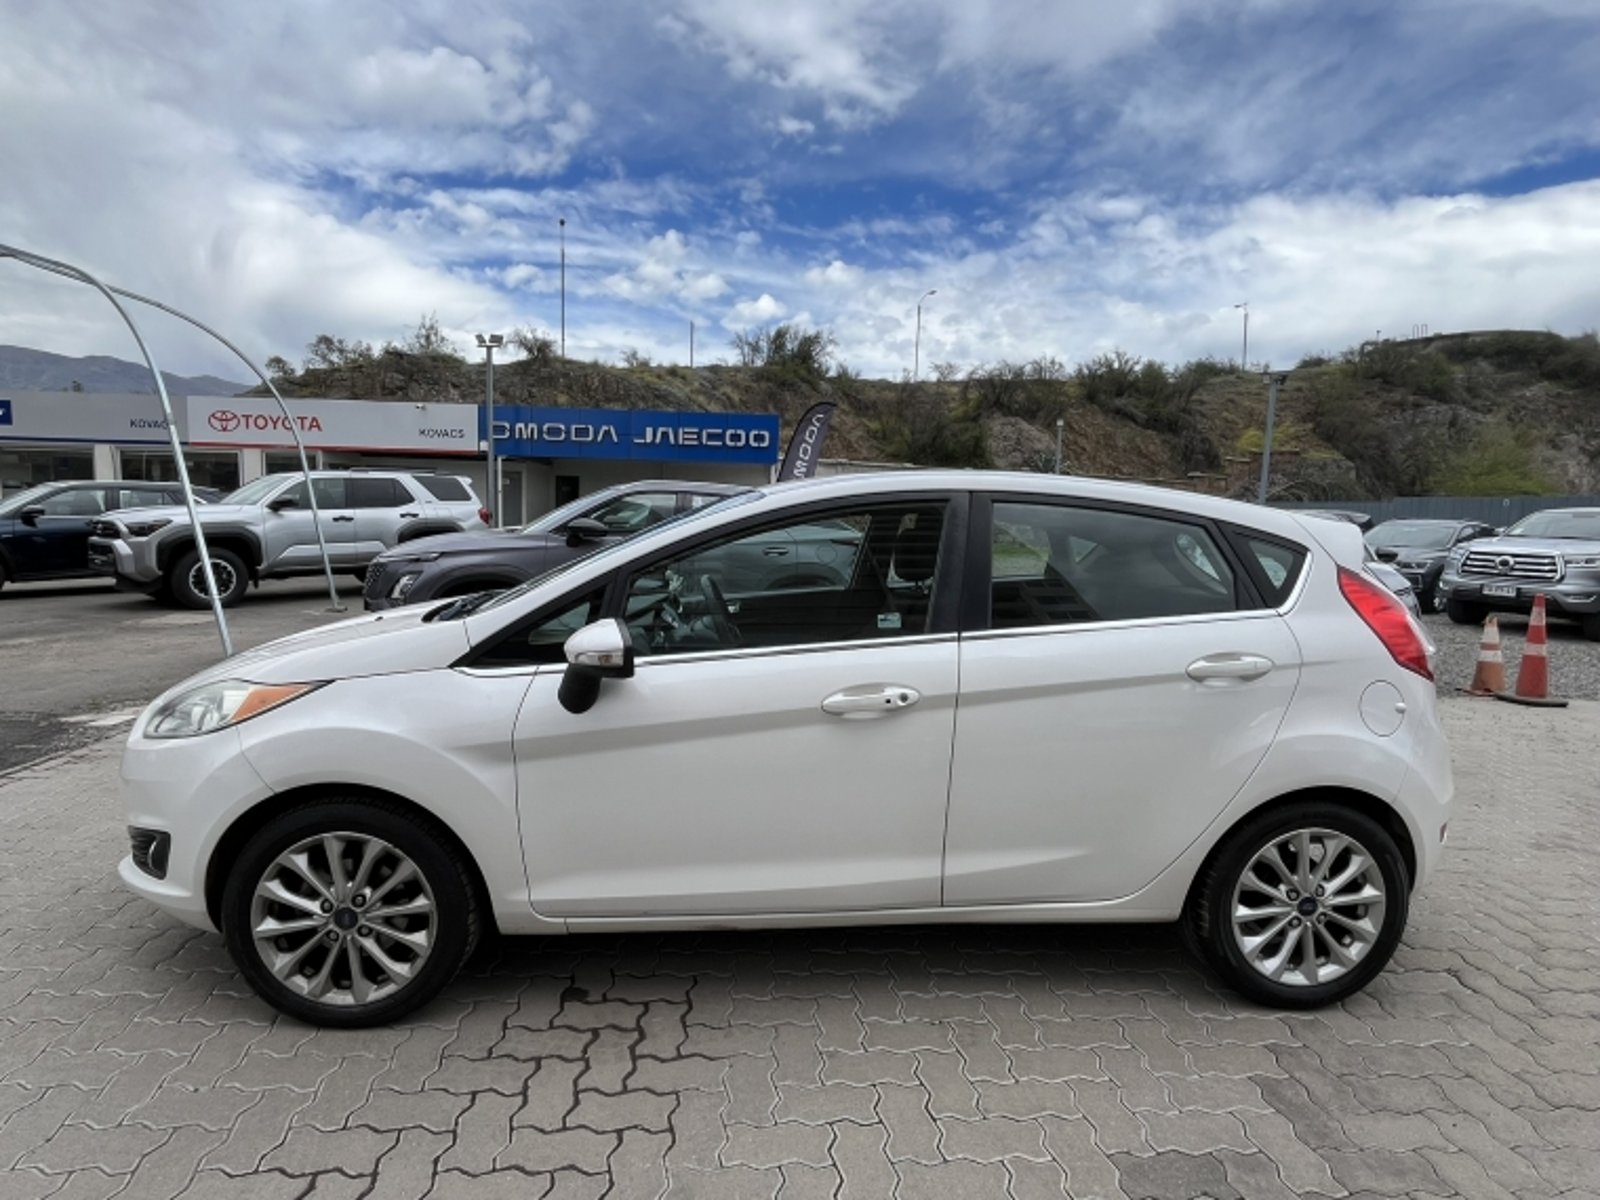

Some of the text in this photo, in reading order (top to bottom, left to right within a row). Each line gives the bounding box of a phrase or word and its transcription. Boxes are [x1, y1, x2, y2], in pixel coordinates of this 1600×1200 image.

[130, 418, 170, 430] KOVAC
[241, 414, 323, 432] TOYOTA
[419, 428, 465, 439] KOVACS
[633, 426, 770, 447] JAECOO
[793, 414, 824, 478] MODA
